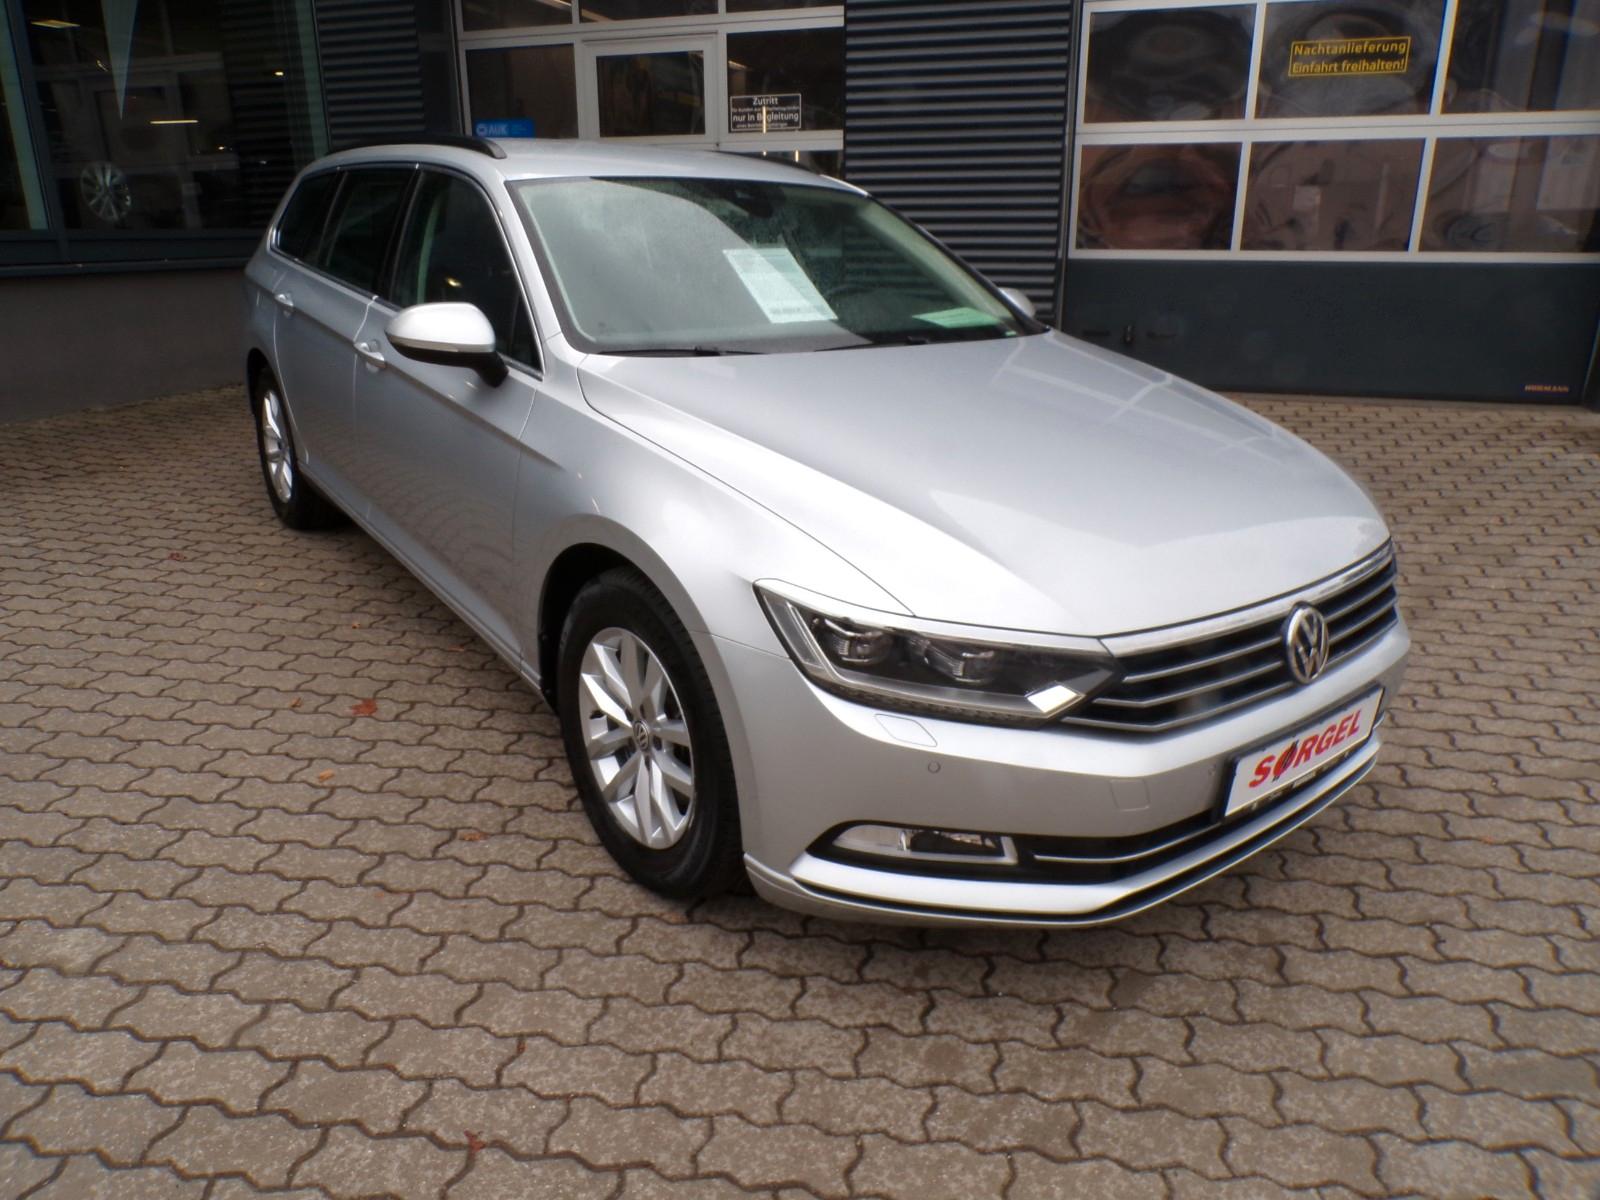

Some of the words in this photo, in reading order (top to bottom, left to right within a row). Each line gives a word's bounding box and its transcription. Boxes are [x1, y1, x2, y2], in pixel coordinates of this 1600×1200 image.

[1294, 41, 1407, 56] Nachtanlieferung
[1292, 60, 1338, 73] Einfahrt
[1341, 58, 1405, 72] freihalten!
[752, 96, 779, 106] Zutritt
[732, 113, 746, 122] nur
[747, 112, 756, 121] in
[756, 111, 799, 123] Bgleitung
